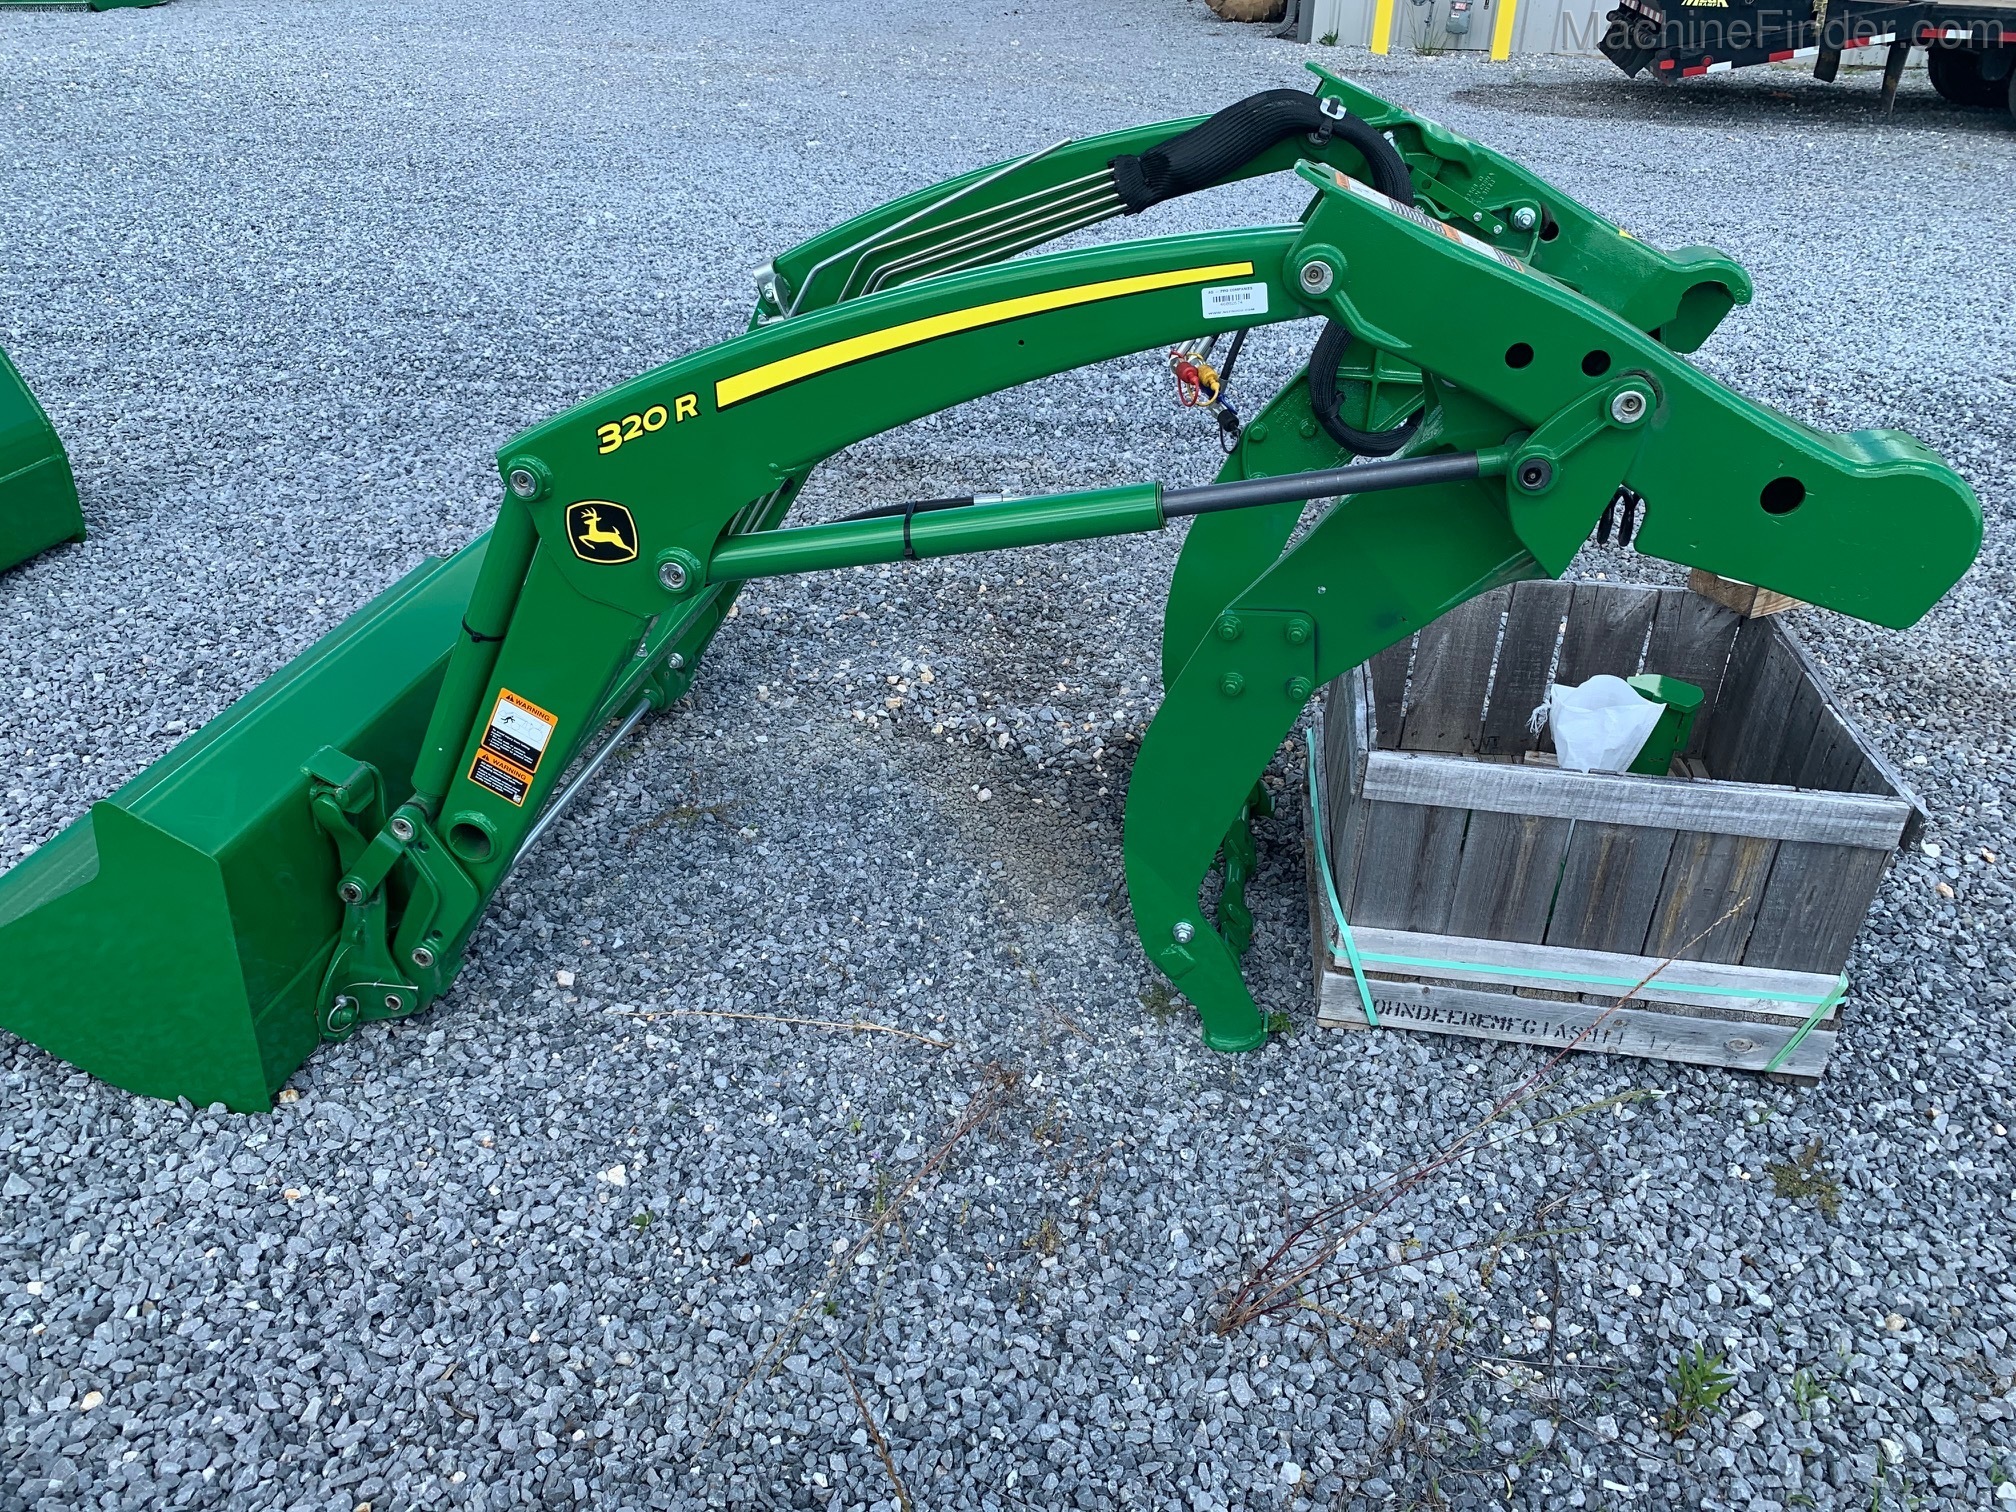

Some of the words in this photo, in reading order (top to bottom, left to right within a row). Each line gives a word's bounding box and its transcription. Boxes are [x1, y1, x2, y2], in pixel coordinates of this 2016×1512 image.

[597, 404, 669, 454] 320
[674, 391, 700, 423] R
[515, 698, 551, 722] WARNING
[492, 758, 527, 780] WARNING
